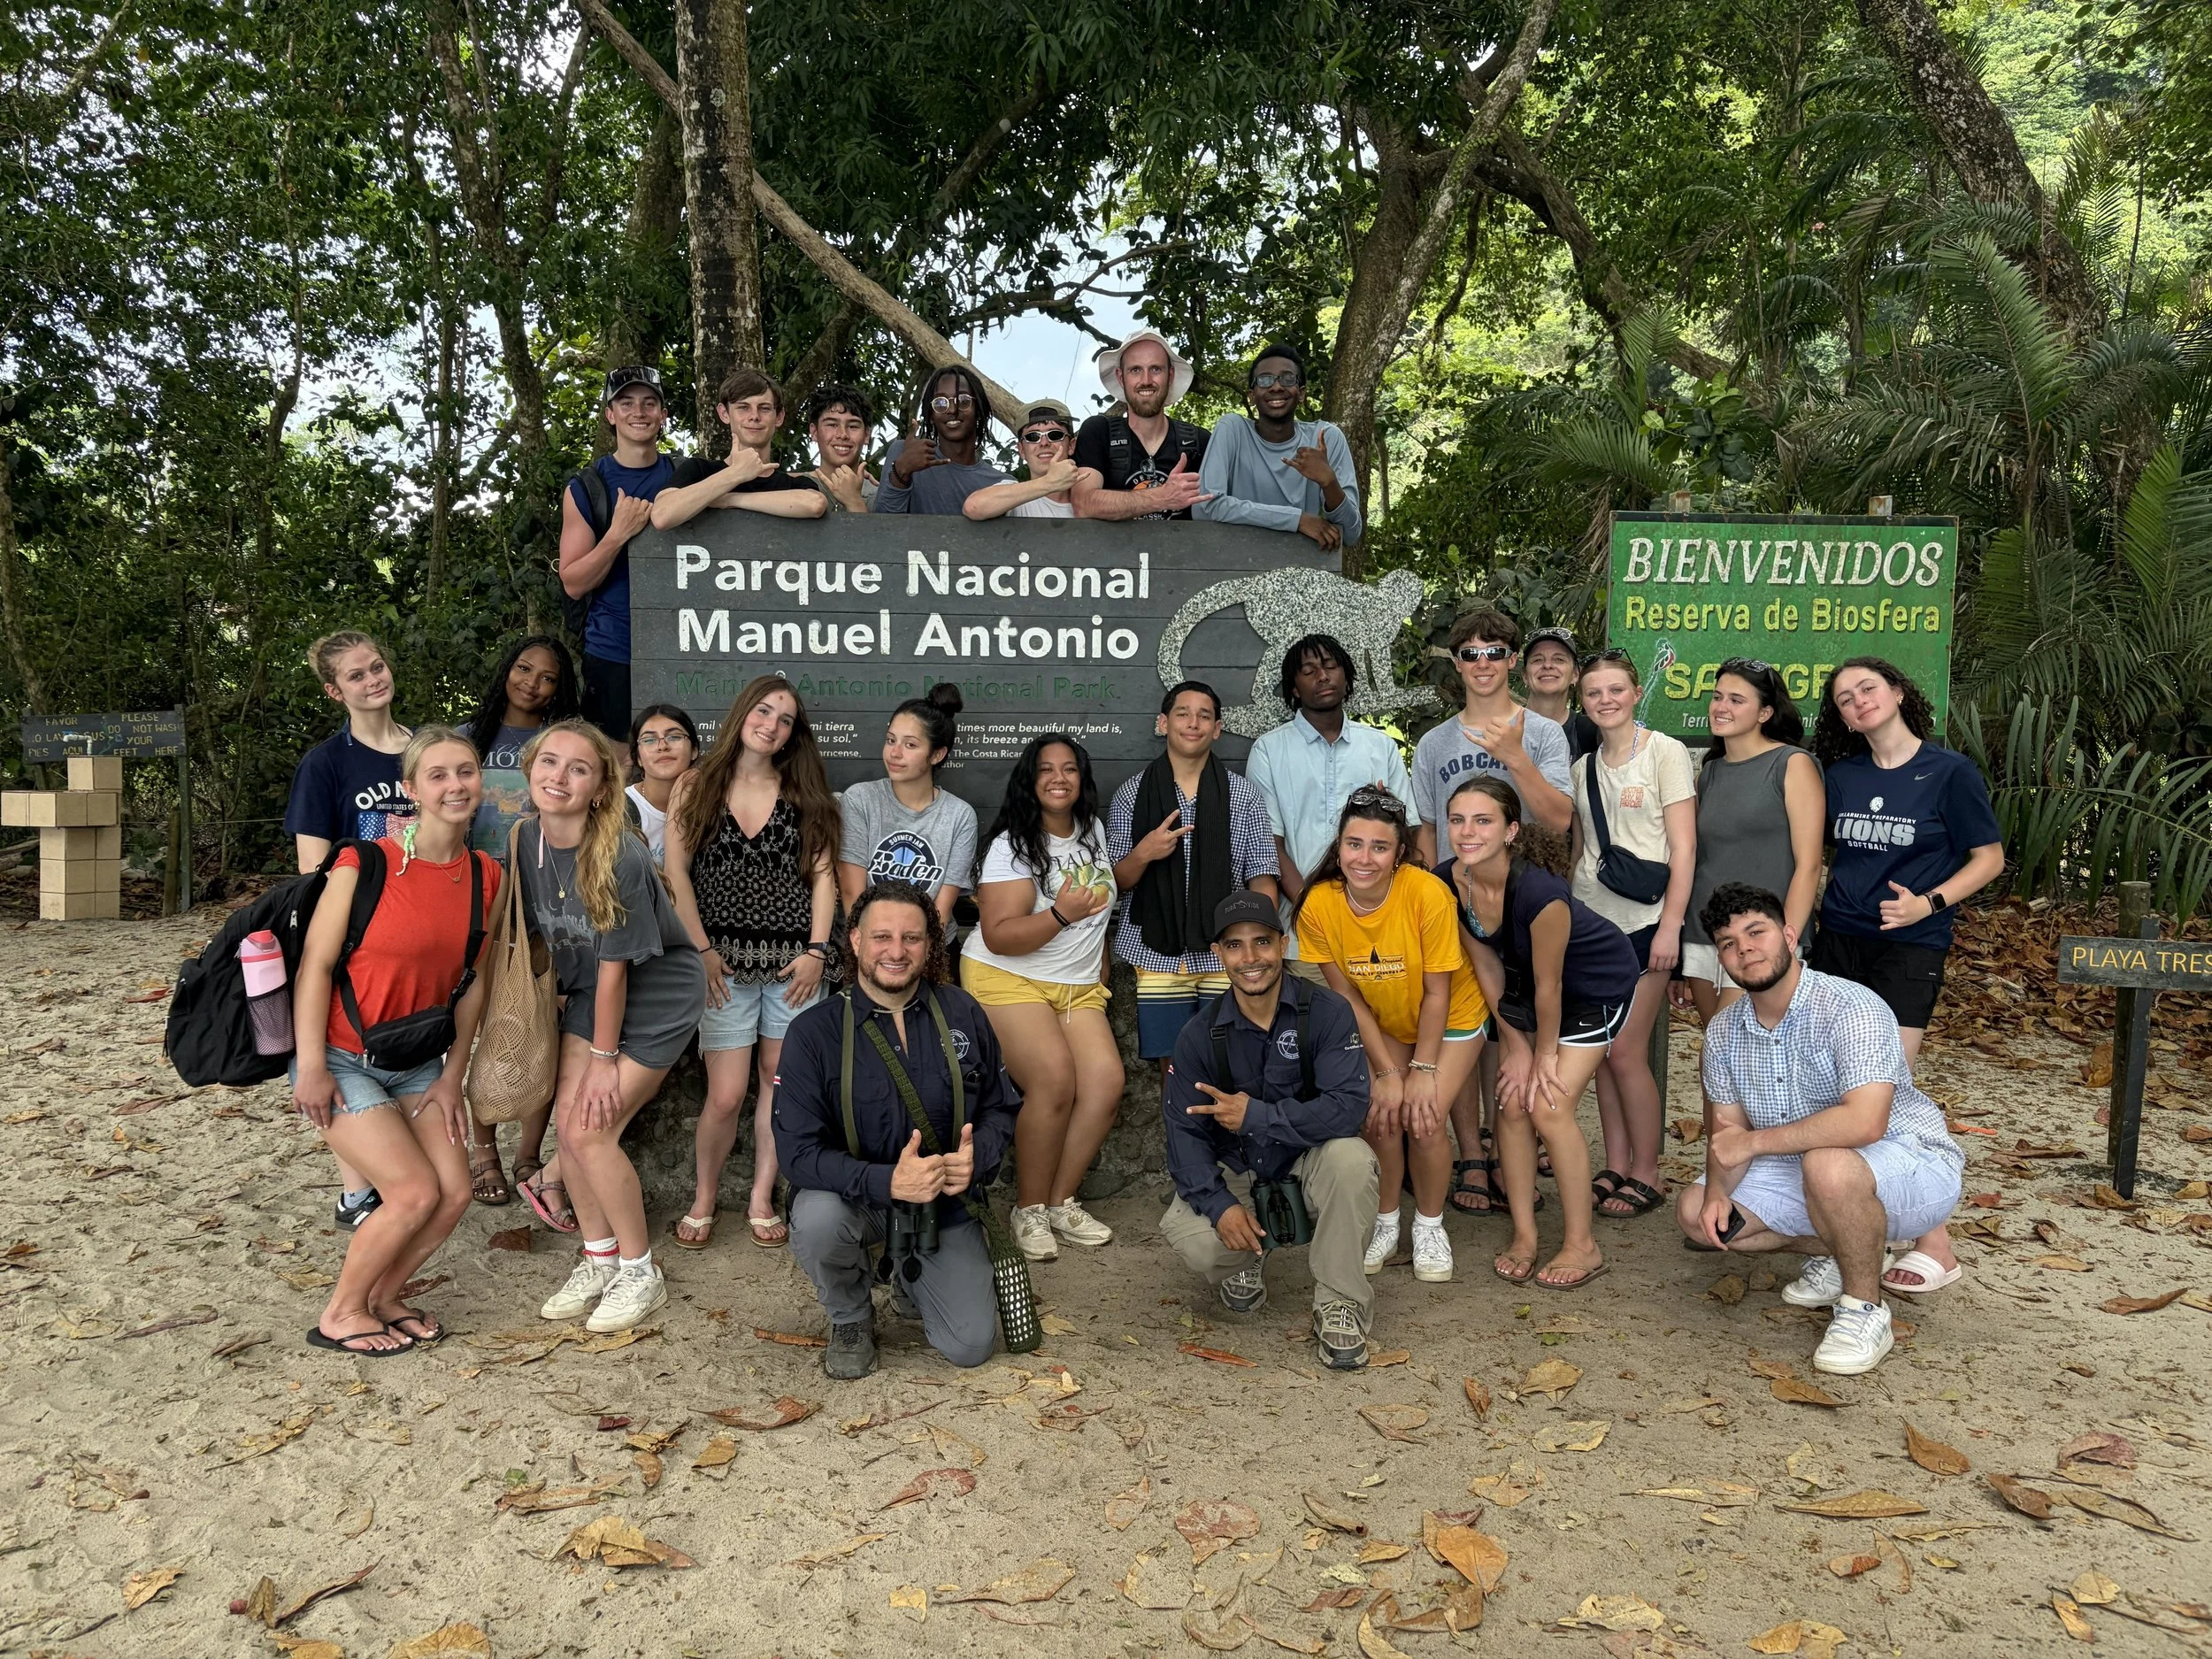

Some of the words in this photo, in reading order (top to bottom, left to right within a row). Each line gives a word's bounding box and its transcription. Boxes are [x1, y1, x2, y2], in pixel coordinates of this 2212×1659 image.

[1623, 537, 1944, 587] BIENVENIDOS
[676, 544, 883, 605] Parque
[907, 550, 1149, 599] Nacional
[1626, 595, 1750, 631] Reserva
[1763, 597, 1799, 631] de
[1811, 597, 1940, 633] Biosfera
[679, 608, 890, 656] Manuel
[914, 612, 1139, 660] Antonio
[797, 673, 912, 698] Antonio
[924, 675, 1043, 700] Ntional
[45, 717, 78, 726] FAVOR
[121, 713, 159, 722] PLEASE
[108, 725, 121, 733] DO
[133, 725, 152, 733] NOT
[155, 723, 180, 732] WASH
[699, 720, 716, 730] mil
[826, 721, 855, 731] tierra
[956, 722, 986, 733] times
[1018, 722, 1065, 733] beautiful
[1067, 725, 1083, 734] my
[1086, 723, 1109, 733] land
[1111, 724, 1123, 734] is,
[966, 734, 979, 744] its
[982, 734, 1018, 744] breeze
[62, 746, 83, 755] AQUI
[113, 748, 138, 757] FEET
[355, 782, 391, 810] OLD
[1871, 814, 1916, 825] PREPARATORY
[1834, 818, 1916, 846] LIONS
[888, 834, 913, 845] SUMMER
[1847, 841, 1888, 852] SOFTBALL
[868, 849, 944, 881] Baden
[2072, 947, 2148, 971] PLAYA
[1374, 963, 1404, 972] DIEGO
